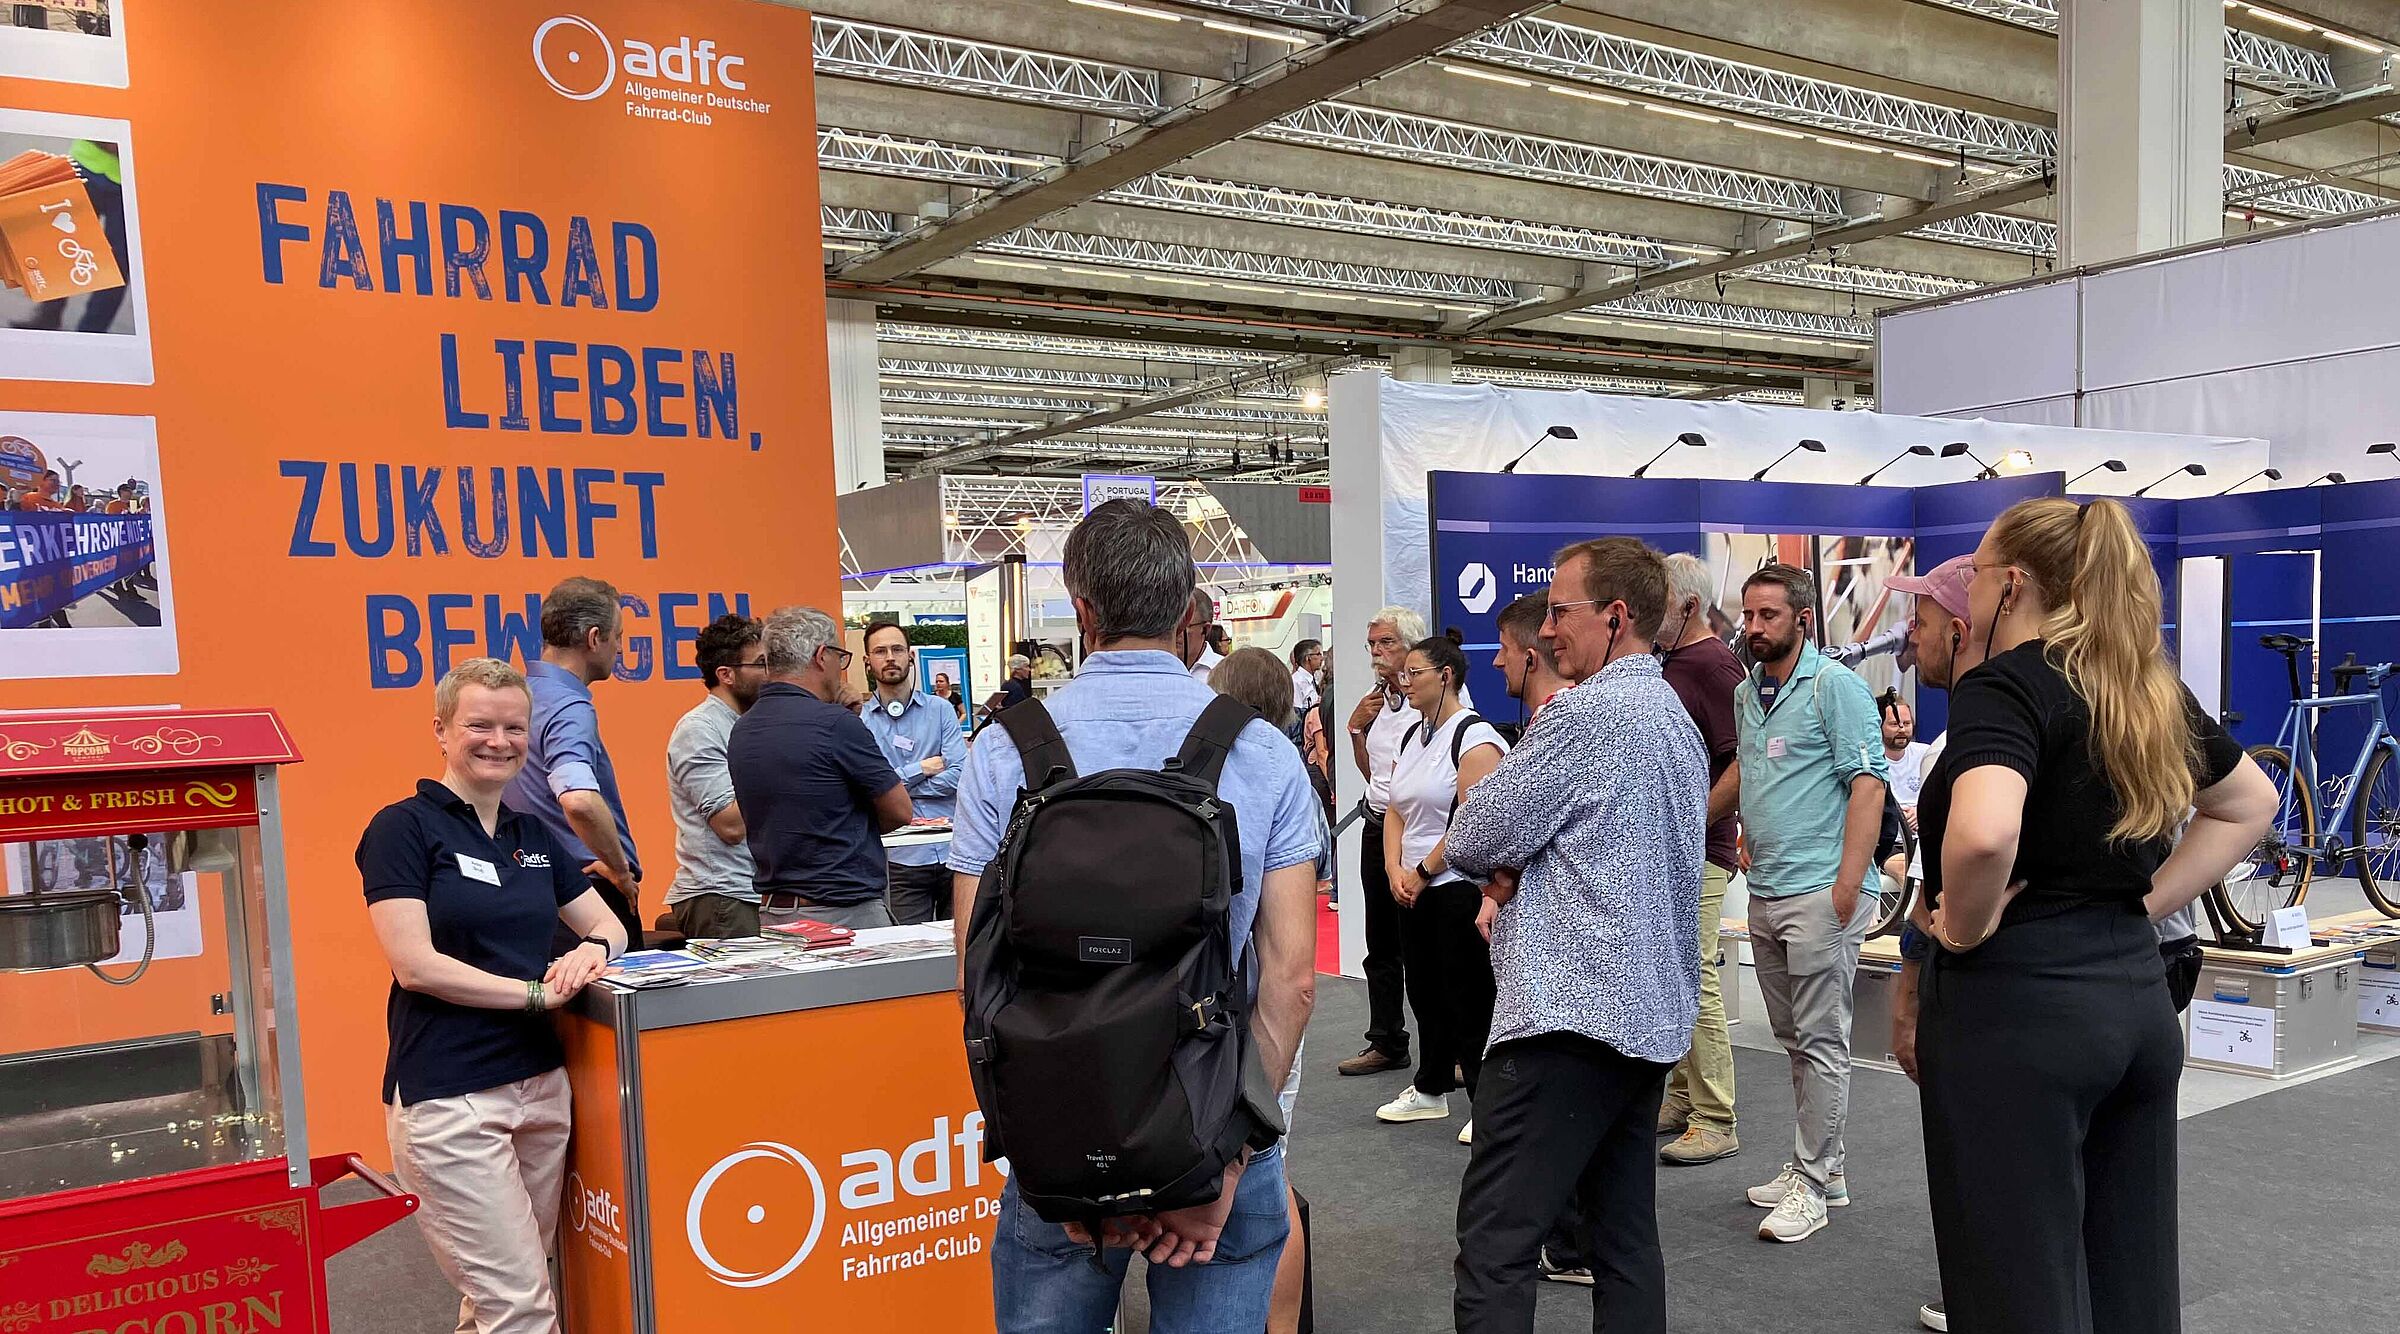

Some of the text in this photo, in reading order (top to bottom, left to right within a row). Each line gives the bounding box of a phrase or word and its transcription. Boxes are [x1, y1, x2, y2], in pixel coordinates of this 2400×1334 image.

[623, 36, 746, 91] adfc
[624, 80, 772, 114] Allgemeiner Deutscher
[626, 102, 712, 126] Fahrrad-Club
[255, 181, 660, 313] FAHRRAD
[440, 332, 762, 451] LIEBEN,
[278, 459, 667, 560] ZUKUNFT
[1106, 486, 1150, 495] PORTUGAL
[1226, 598, 1266, 615] DARFON
[365, 592, 752, 690] BEWGE
[63, 744, 112, 757] POPCORN
[0, 788, 176, 815] HOT & FRESH
[1088, 946, 1122, 954] FORCLAZ
[2374, 1008, 2381, 1016] 4
[2228, 1045, 2234, 1053] 3
[586, 1188, 620, 1233] adfc
[840, 1204, 969, 1247] Allgemeiner
[842, 1232, 981, 1282] Fahrrad-Club
[48, 1268, 220, 1322] DELICIOUS
